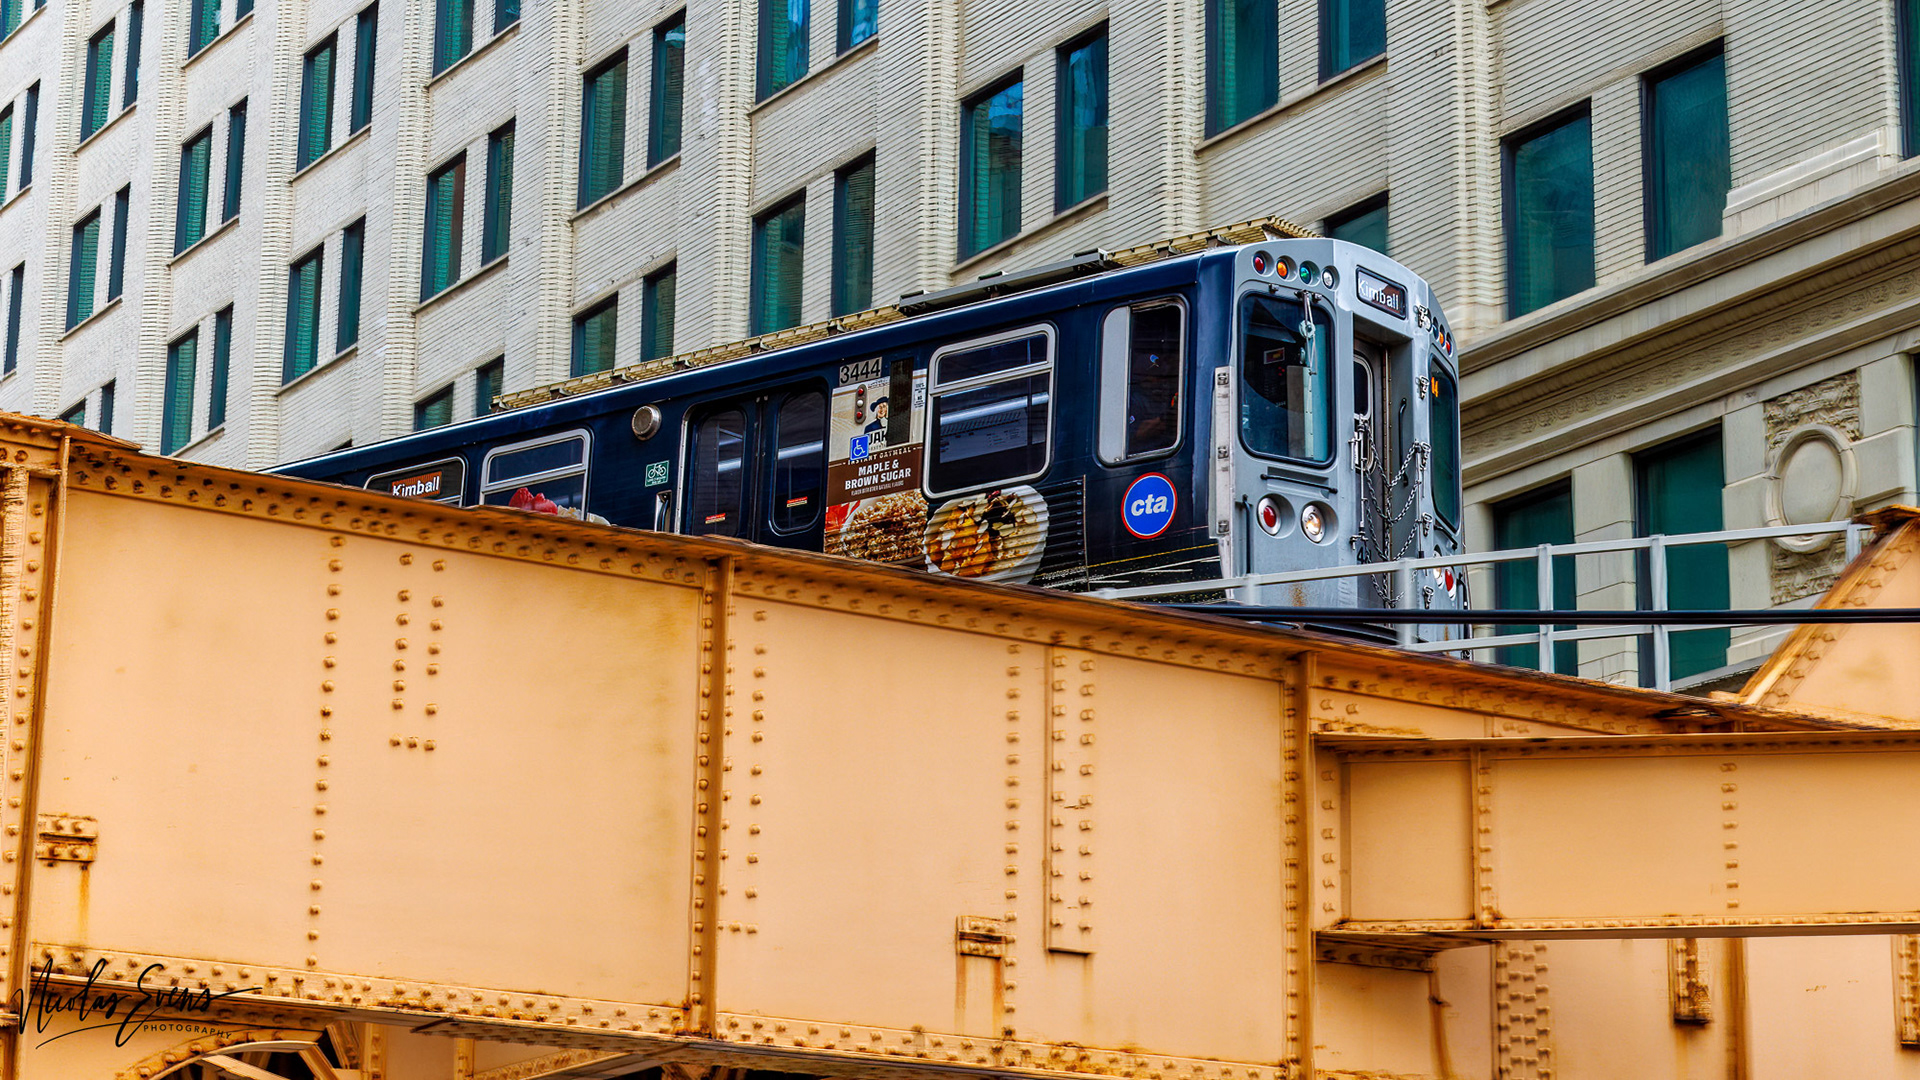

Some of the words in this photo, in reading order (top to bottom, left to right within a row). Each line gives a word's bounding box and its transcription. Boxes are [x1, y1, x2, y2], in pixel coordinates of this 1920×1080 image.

[1358, 278, 1399, 310] Kimball
[840, 359, 880, 383] 3444
[879, 446, 912, 459] OATMEAL
[844, 474, 879, 490] BROWN
[880, 467, 912, 483] SUGAR
[858, 462, 890, 476] MAPLE
[891, 459, 900, 469] &
[392, 476, 439, 497] Kimball
[1131, 494, 1167, 516] cta
